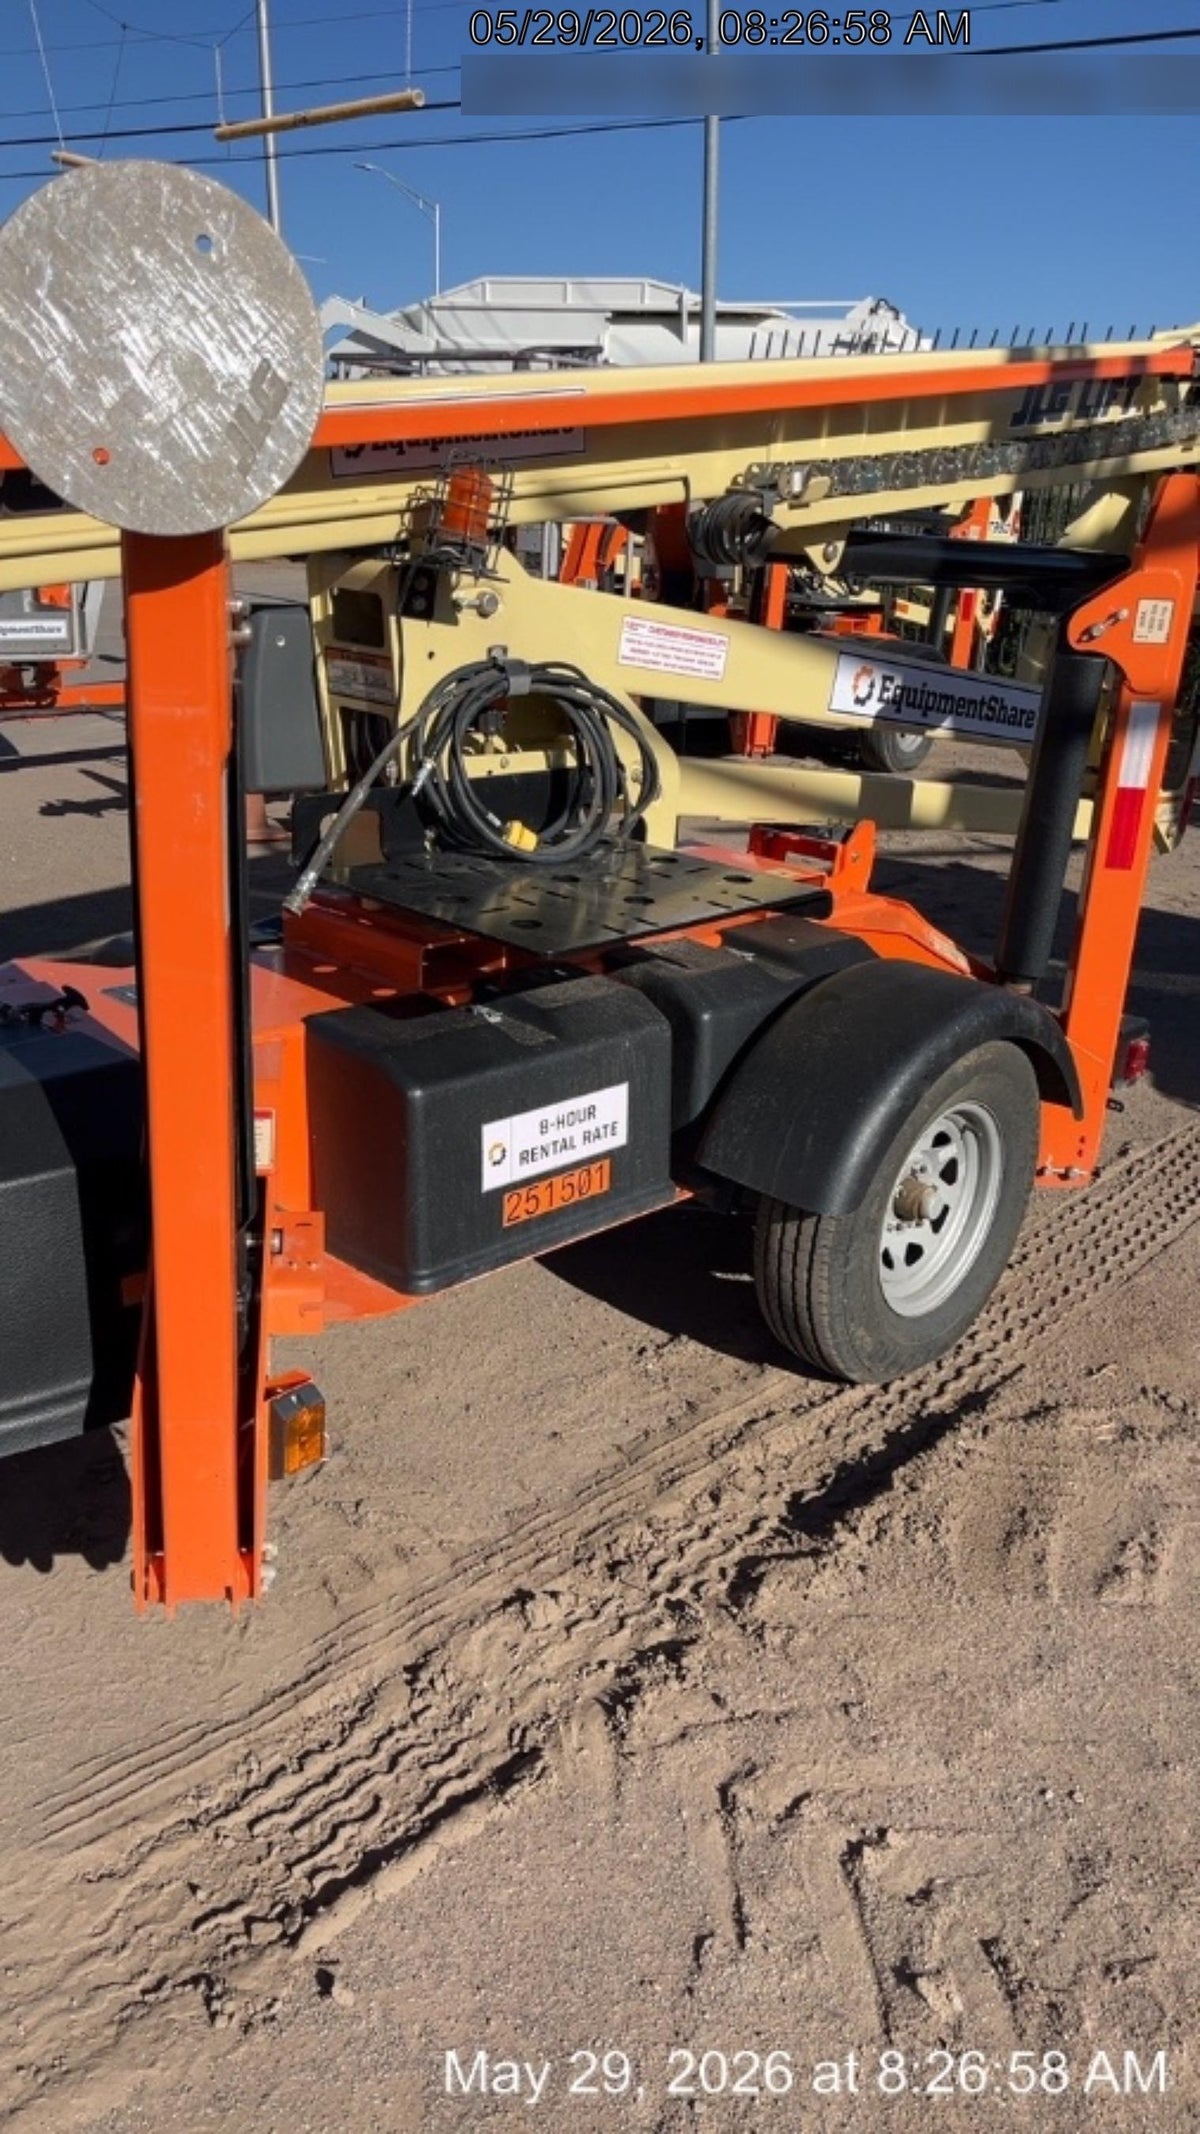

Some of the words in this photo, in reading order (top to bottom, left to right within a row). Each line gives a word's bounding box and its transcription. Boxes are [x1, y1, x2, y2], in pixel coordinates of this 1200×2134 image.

[877, 673, 1035, 729] EquipmentShare
[519, 1136, 577, 1166] RENTAL
[583, 1121, 619, 1145] RATE
[539, 1104, 597, 1136] 8-HOUR
[506, 1165, 604, 1222] 251501
